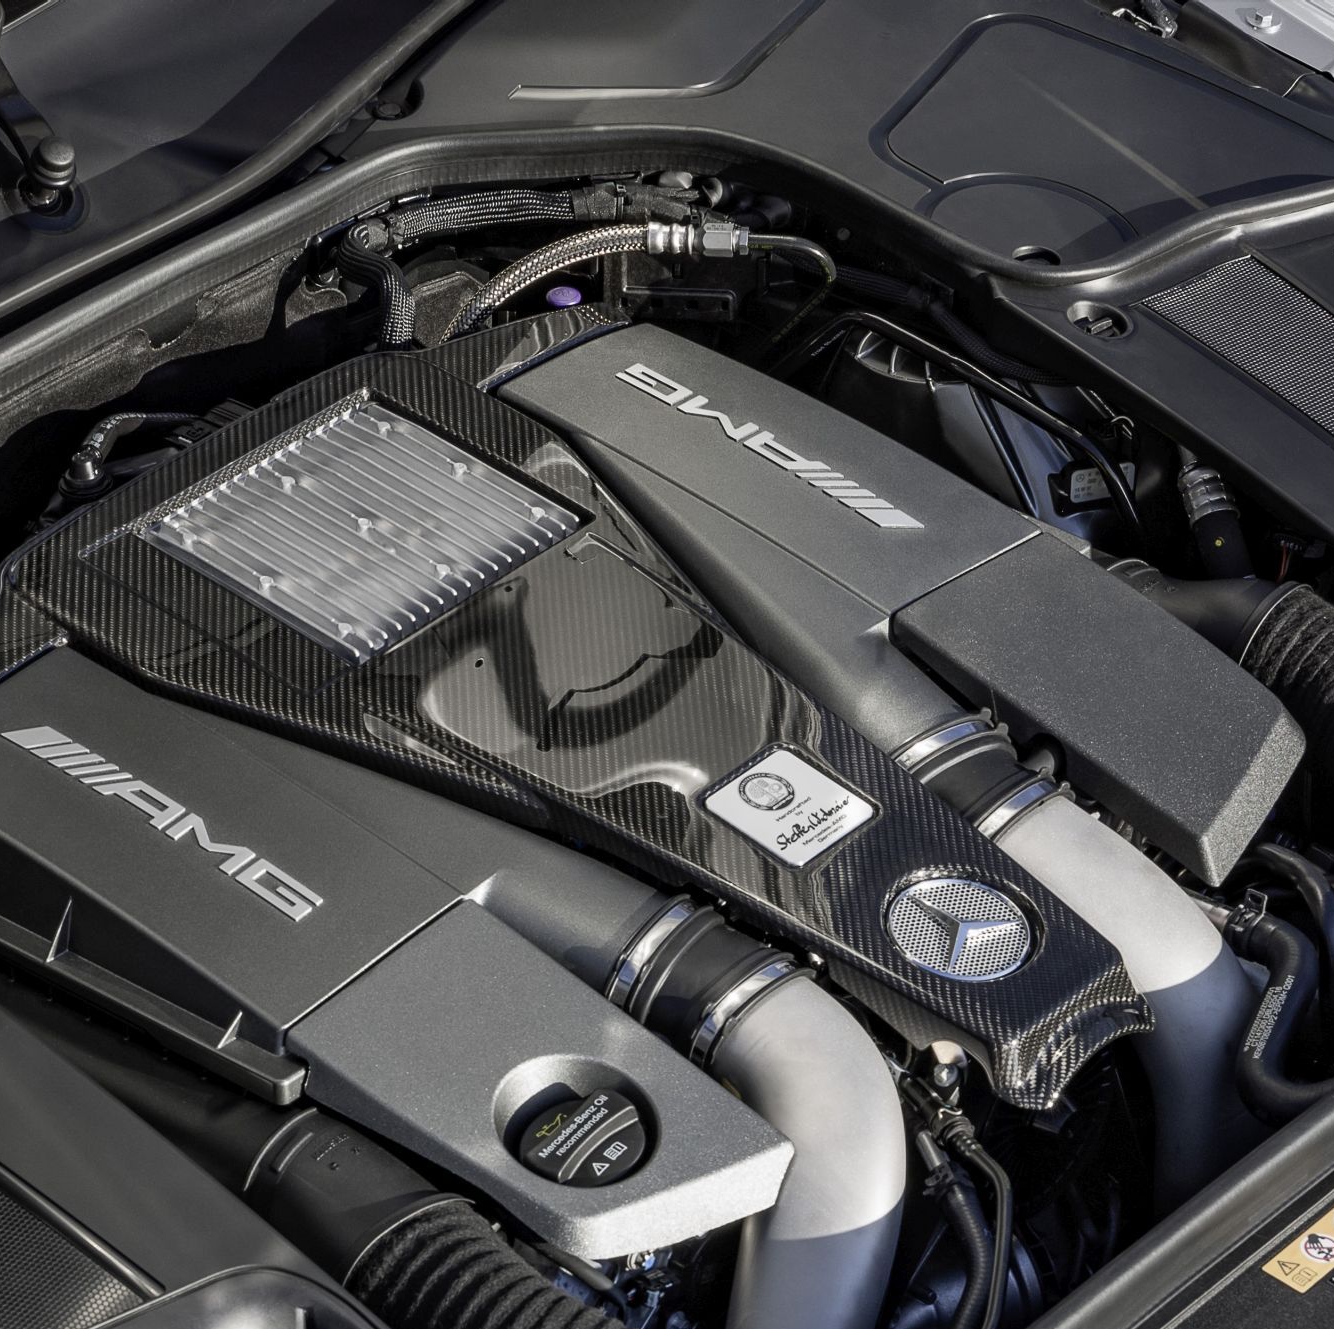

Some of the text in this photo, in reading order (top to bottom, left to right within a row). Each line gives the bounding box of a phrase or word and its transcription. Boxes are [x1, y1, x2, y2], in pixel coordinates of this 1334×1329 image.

[538, 1094, 609, 1159] Mercedes-Benz Oil
[555, 1107, 609, 1157] recommended
